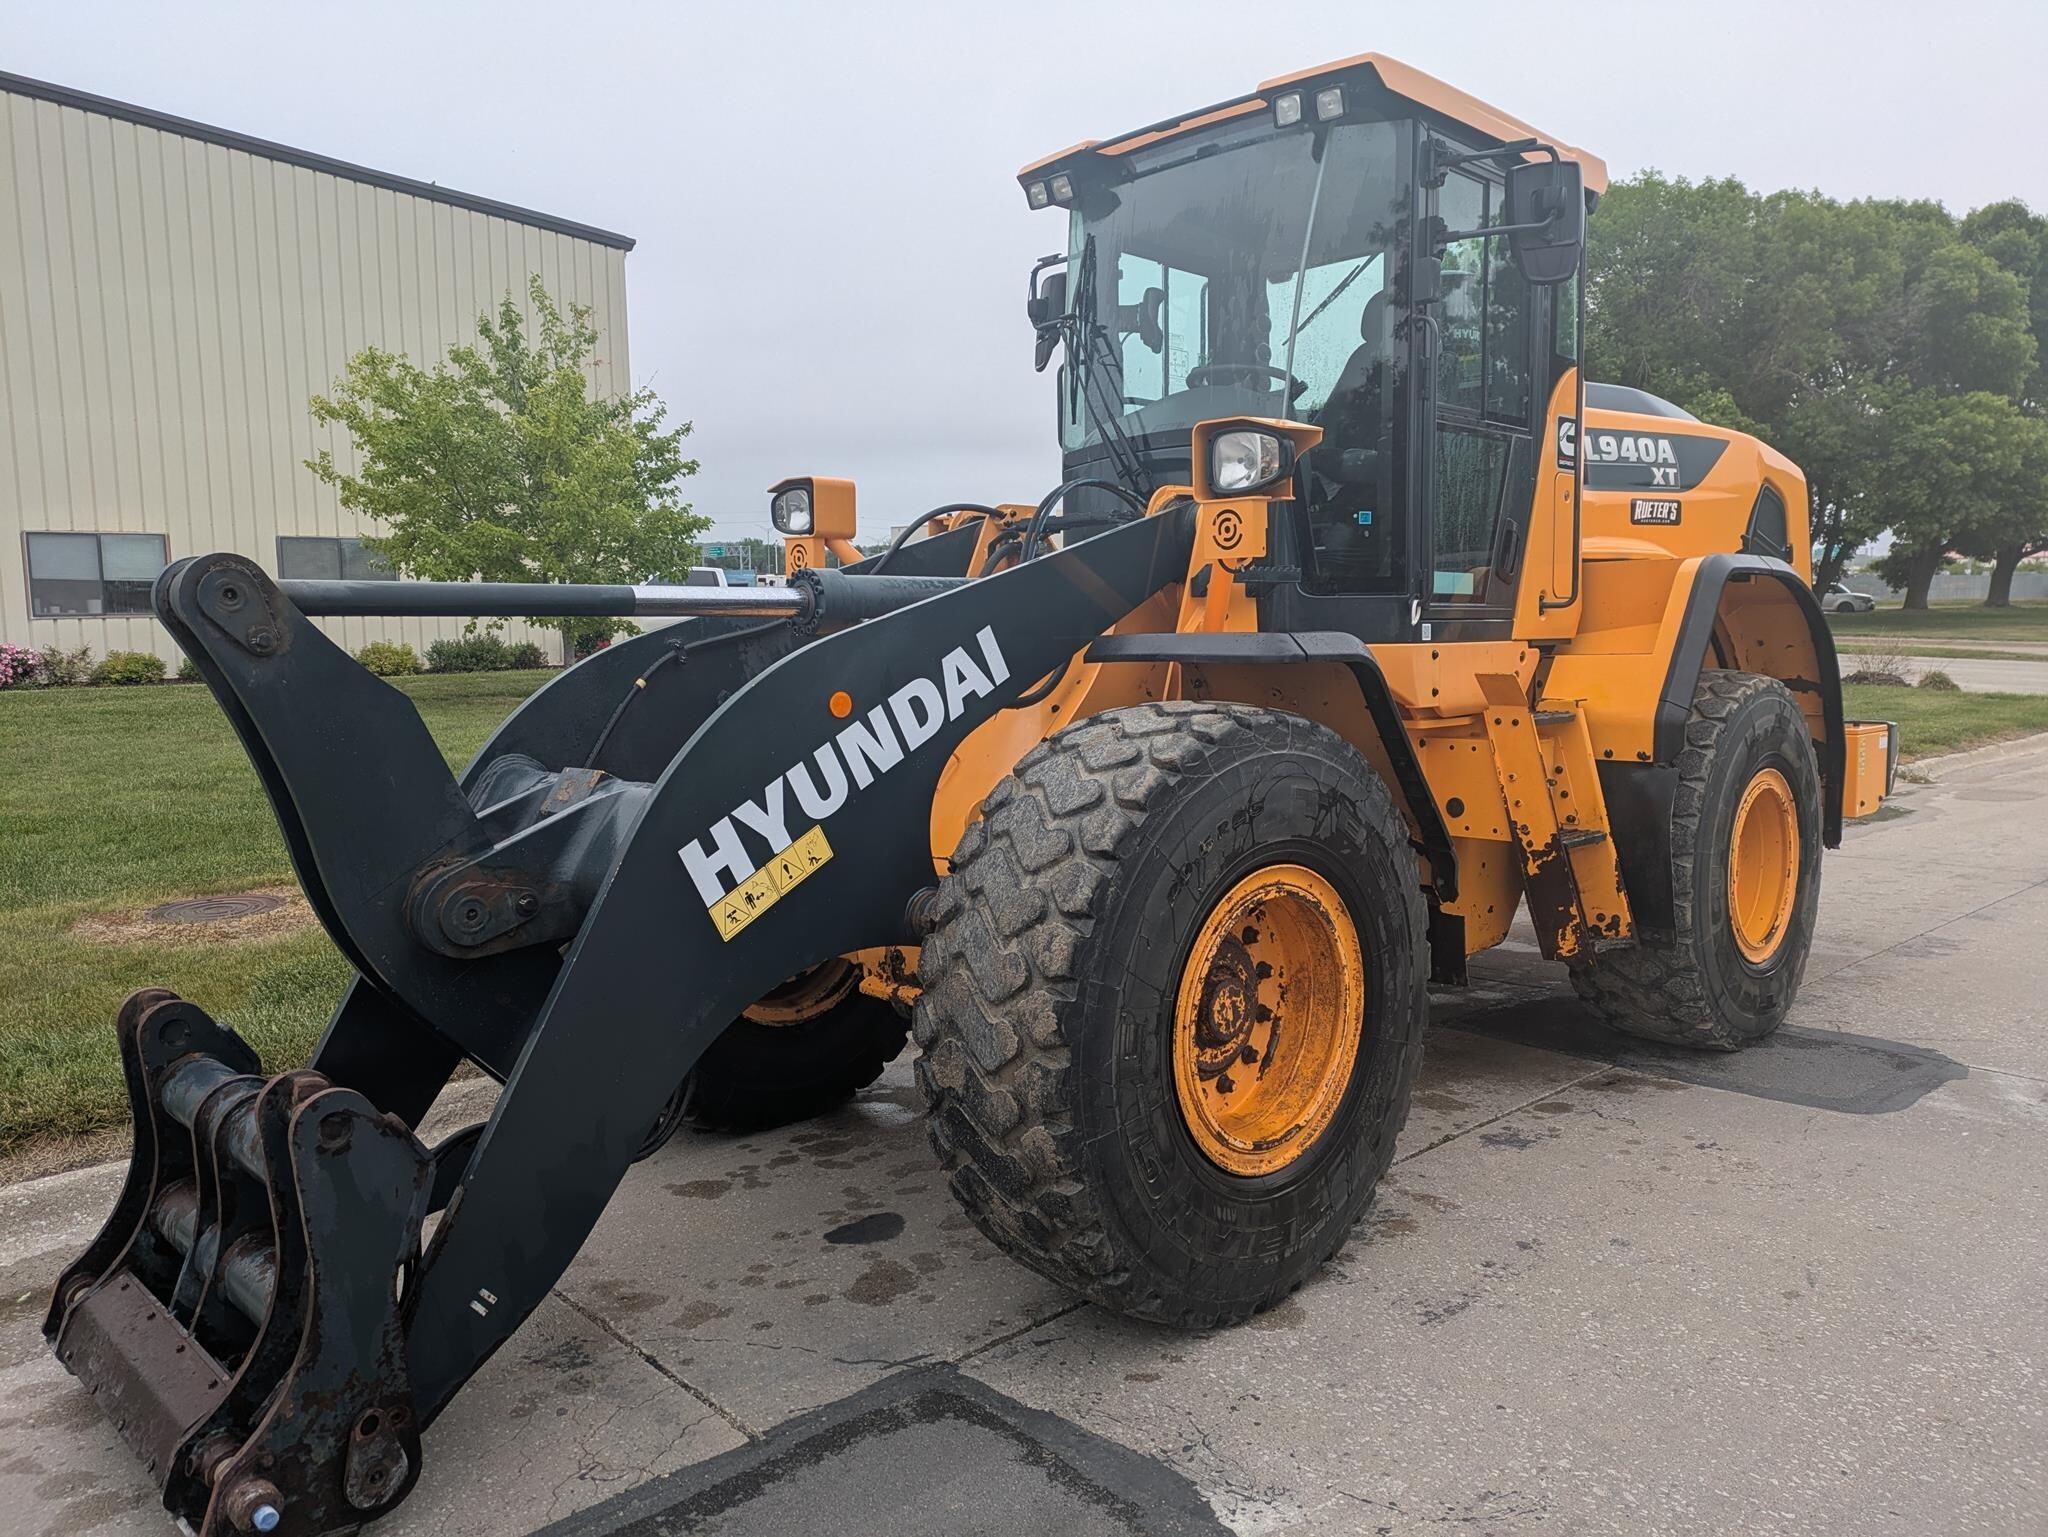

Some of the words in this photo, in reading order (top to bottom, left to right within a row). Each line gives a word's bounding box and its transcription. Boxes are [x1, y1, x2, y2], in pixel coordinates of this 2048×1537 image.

[1584, 435, 1676, 463] L940A
[1650, 467, 1678, 486] XT
[1634, 500, 1678, 521] RUETER'S
[678, 624, 1011, 909] HYUNDAI
